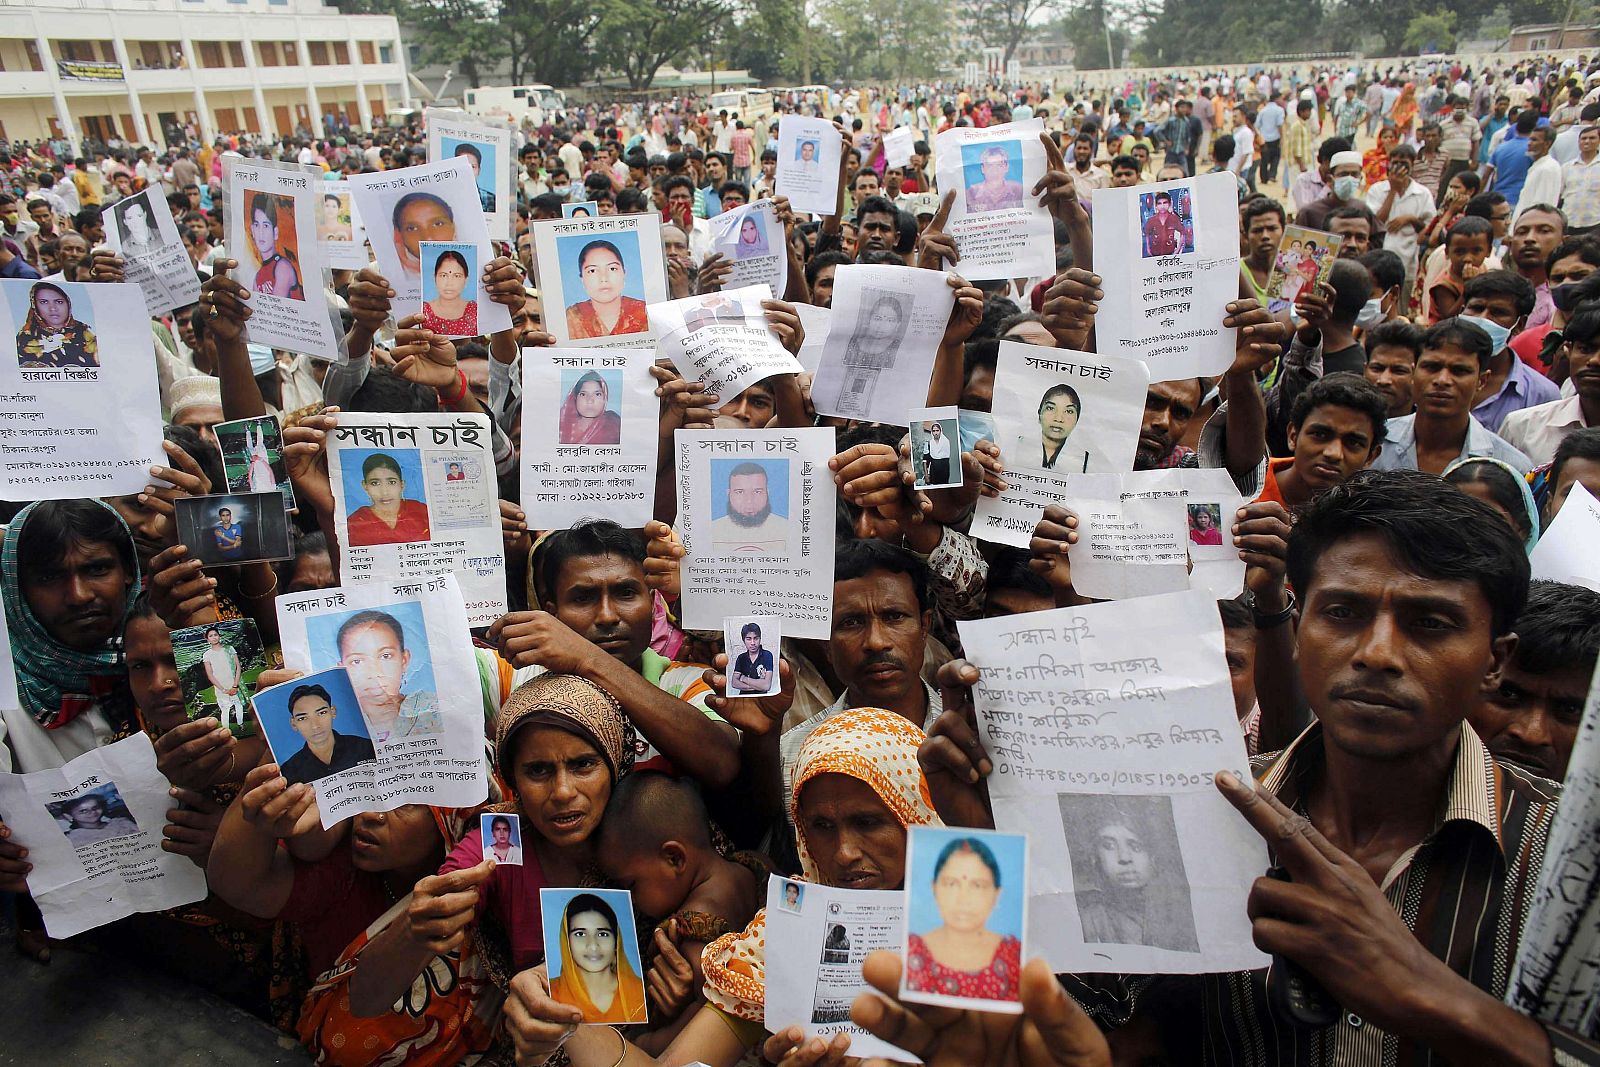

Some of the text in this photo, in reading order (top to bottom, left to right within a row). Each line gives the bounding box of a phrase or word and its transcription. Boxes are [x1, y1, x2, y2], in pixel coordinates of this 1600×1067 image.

[249, 172, 259, 183] চাই
[277, 176, 294, 188] সন্ধান
[295, 177, 307, 190] চাই
[366, 181, 389, 193] সন্ধান
[390, 177, 407, 190] চাই
[409, 173, 431, 189] (রানা
[433, 169, 459, 184] প্লাজা)
[581, 221, 596, 231] চাই
[598, 220, 616, 229] রানা
[618, 218, 638, 228] প্লাজা
[552, 356, 628, 367] সন্ধান চাই
[1024, 355, 1114, 383] সন্ধান চাই
[21, 370, 61, 381] হারানো
[0, 393, 36, 403] াম:শরিফা
[335, 418, 486, 449] সন্ধান চাই
[698, 437, 800, 454] সন্ধান চাই
[556, 446, 621, 457] বুলবুলি বেগম
[531, 462, 552, 473] স্বামী
[617, 463, 647, 473] হোসেন
[1051, 479, 1067, 487] আ
[536, 493, 559, 502] মোবা
[406, 542, 428, 551] রিনা
[430, 540, 466, 549] আক্তার
[350, 557, 454, 571] মাতা রাবেয়া বেগম
[689, 567, 715, 575] পিতাঃ
[759, 568, 790, 576] মালেক
[393, 577, 448, 599] সন্ধান চাই
[688, 587, 726, 595] মোবাইল
[284, 593, 348, 613] সন্ধান চাই
[999, 616, 1097, 651] সন্ধান চাই
[409, 738, 438, 749] আক্তার
[433, 759, 450, 767] জেলা
[80, 774, 101, 789] চাই
[324, 786, 343, 799] রানা
[347, 779, 375, 792] প্লাজার
[419, 771, 434, 780] এর
[437, 771, 477, 781] অপারেটর
